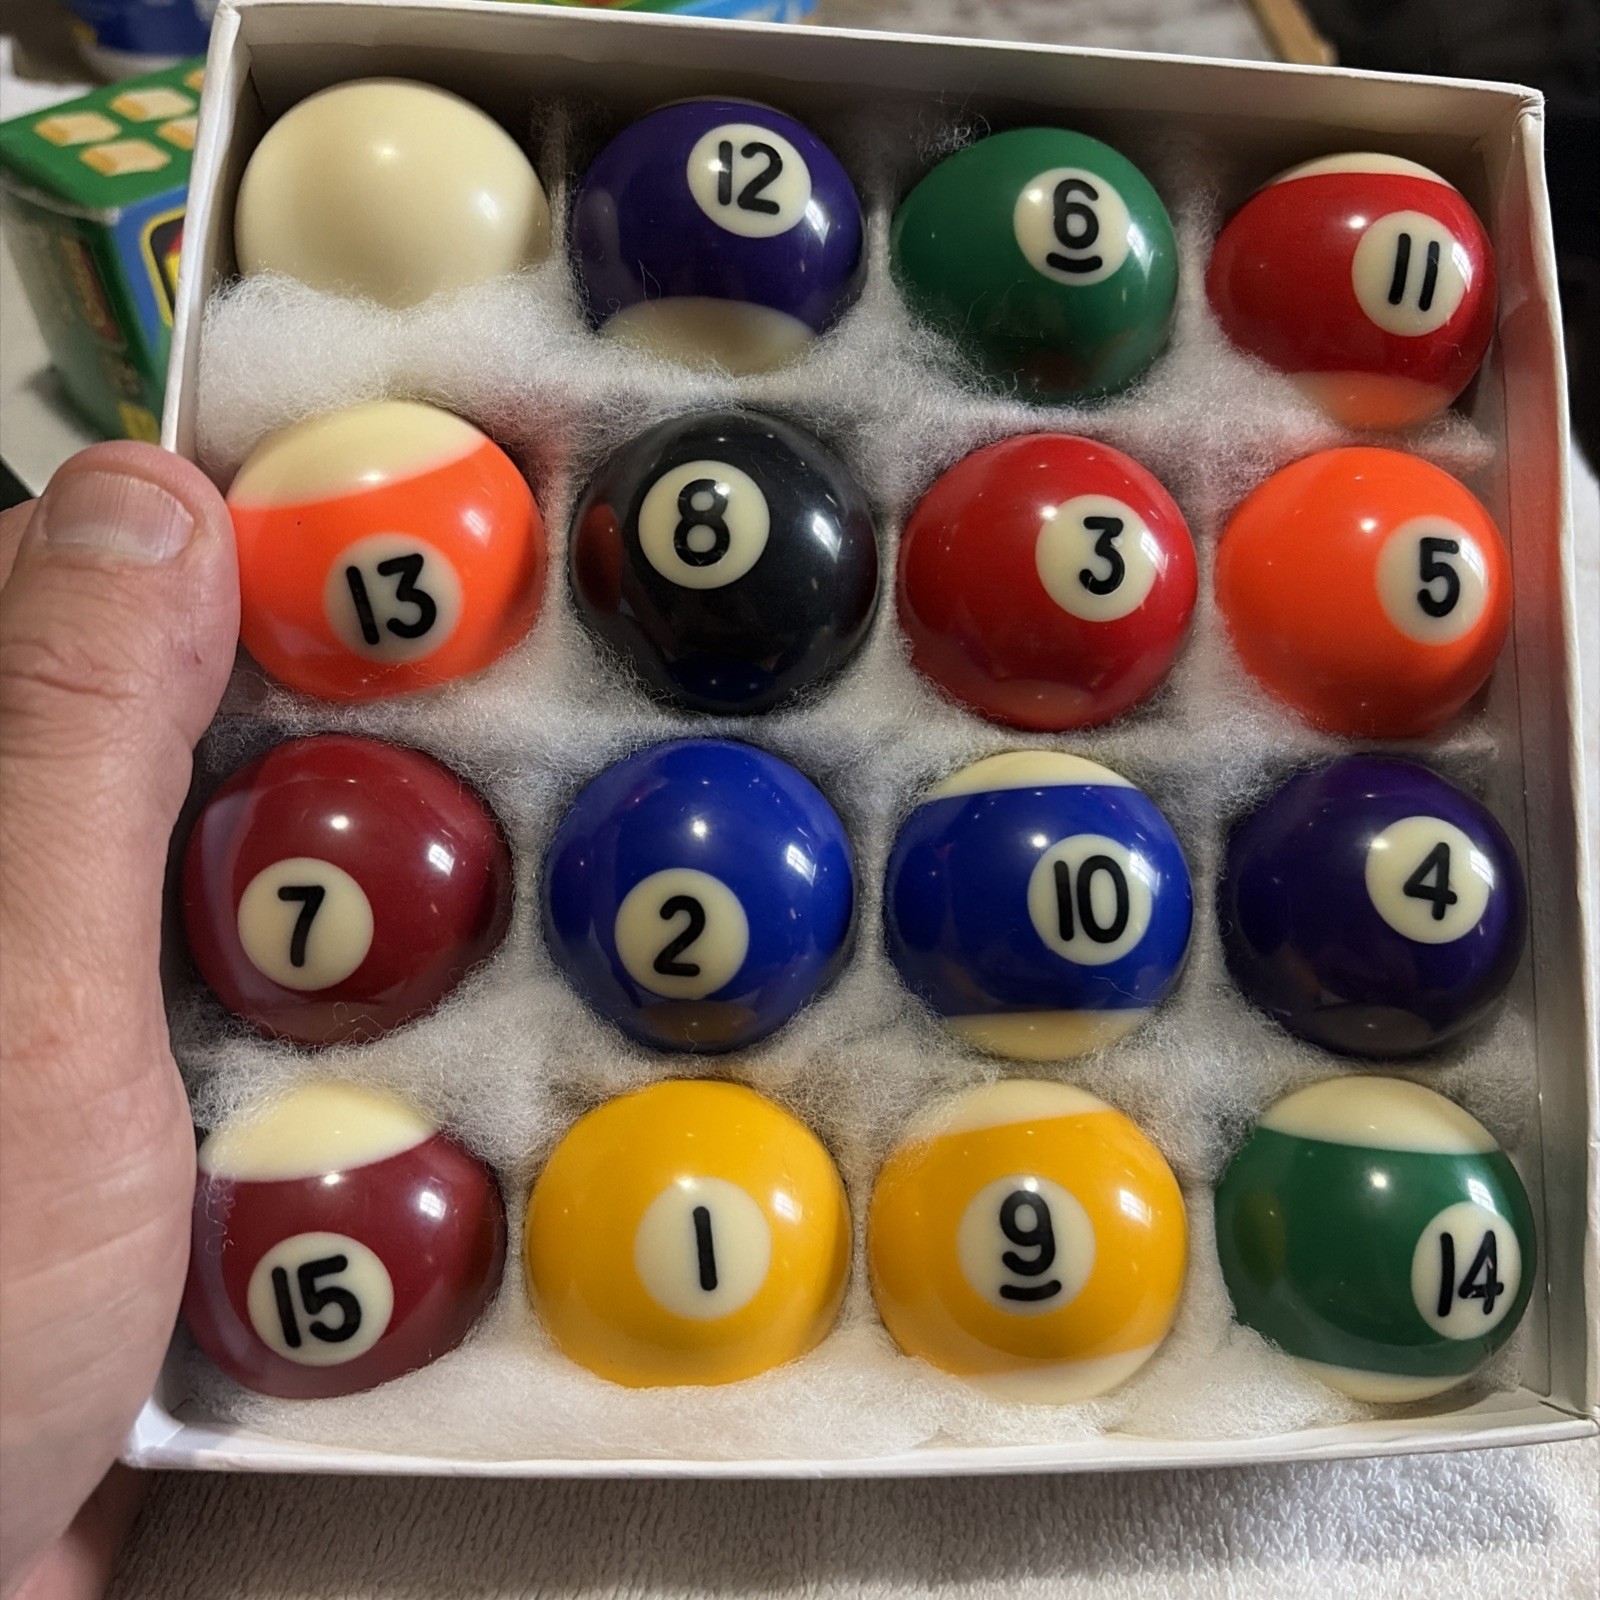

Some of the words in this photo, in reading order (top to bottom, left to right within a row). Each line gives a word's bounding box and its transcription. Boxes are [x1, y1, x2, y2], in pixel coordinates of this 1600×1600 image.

[717, 140, 783, 215] 12
[1046, 179, 1103, 278] 6
[1388, 233, 1440, 312] 11
[674, 479, 731, 567] 8
[1079, 516, 1125, 595] 3
[346, 553, 438, 646] 13
[1417, 537, 1460, 618] 5
[1053, 855, 1129, 944] 10
[1402, 842, 1457, 921] 4
[277, 885, 326, 968] 7
[652, 895, 708, 978] 2
[693, 1206, 718, 1292] 1
[998, 1190, 1062, 1301] 9
[1437, 1230, 1504, 1317] 14
[270, 1254, 362, 1349] 15
